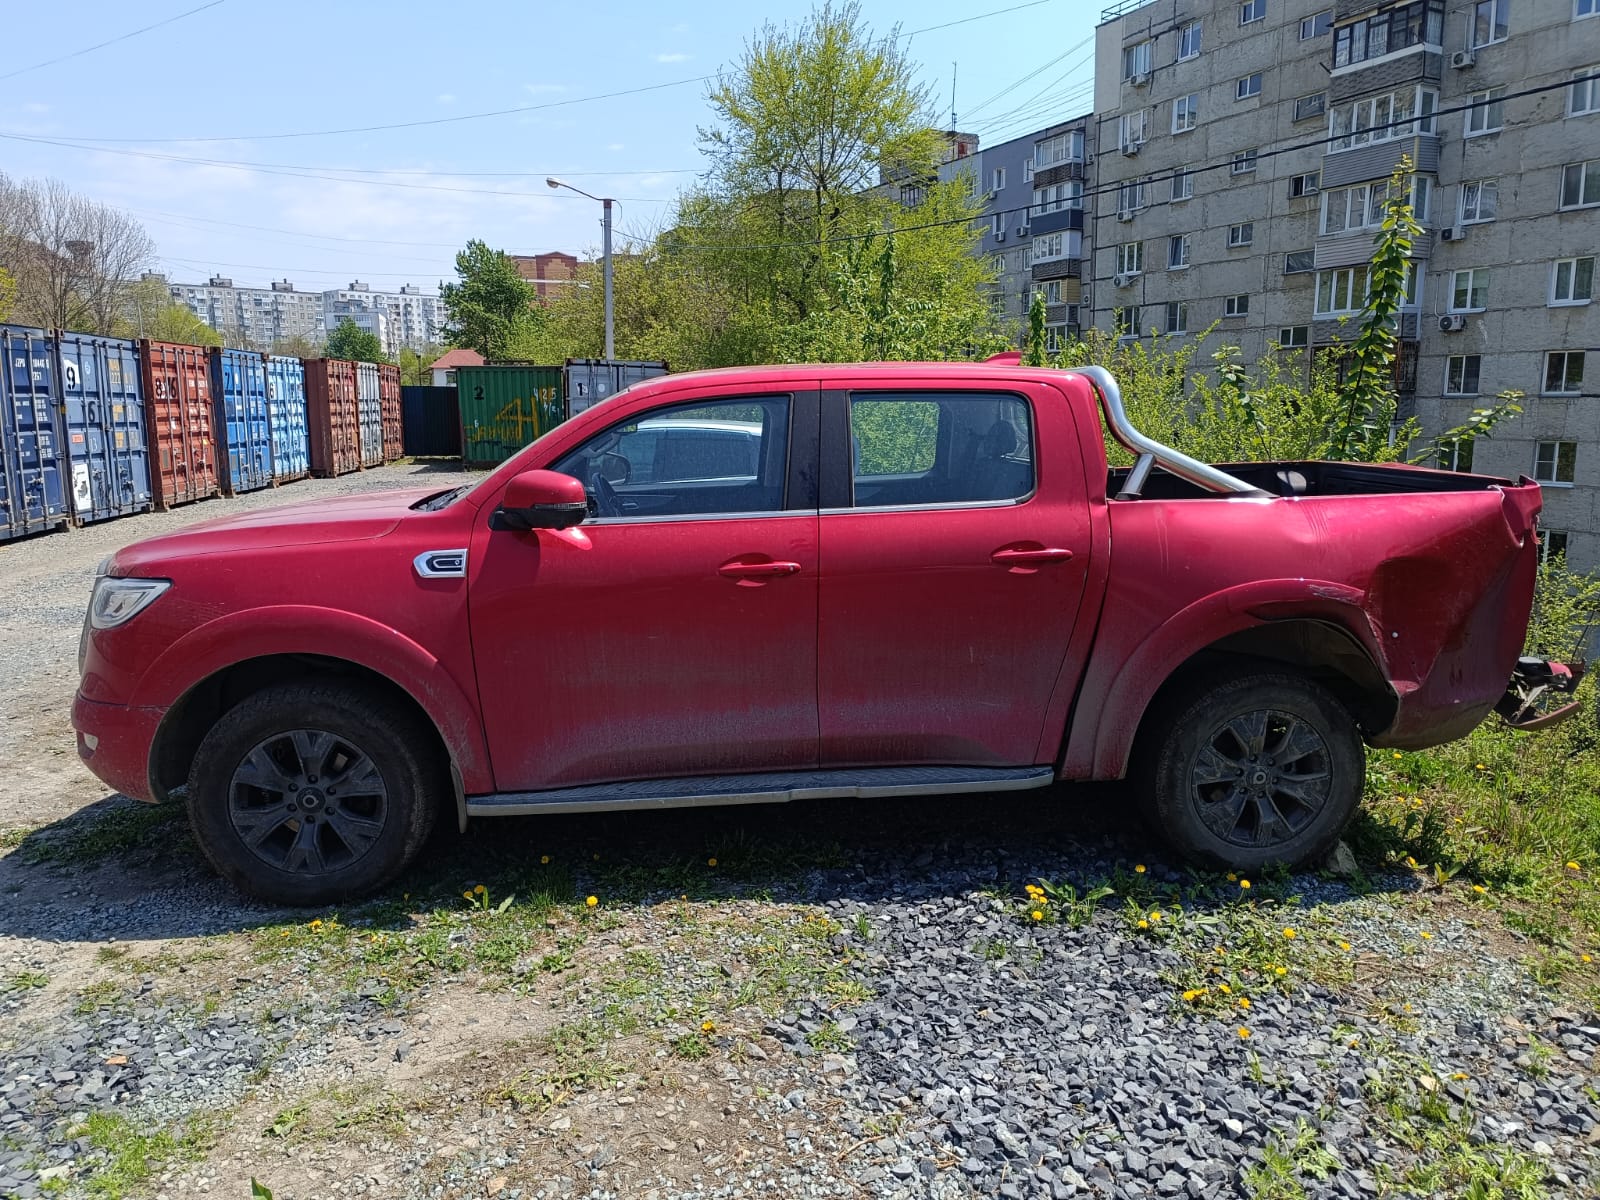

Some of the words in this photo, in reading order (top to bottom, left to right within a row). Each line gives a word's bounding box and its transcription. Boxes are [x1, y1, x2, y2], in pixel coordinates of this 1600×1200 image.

[66, 366, 76, 390] 9
[474, 385, 485, 401] 2
[87, 400, 96, 424] 6
